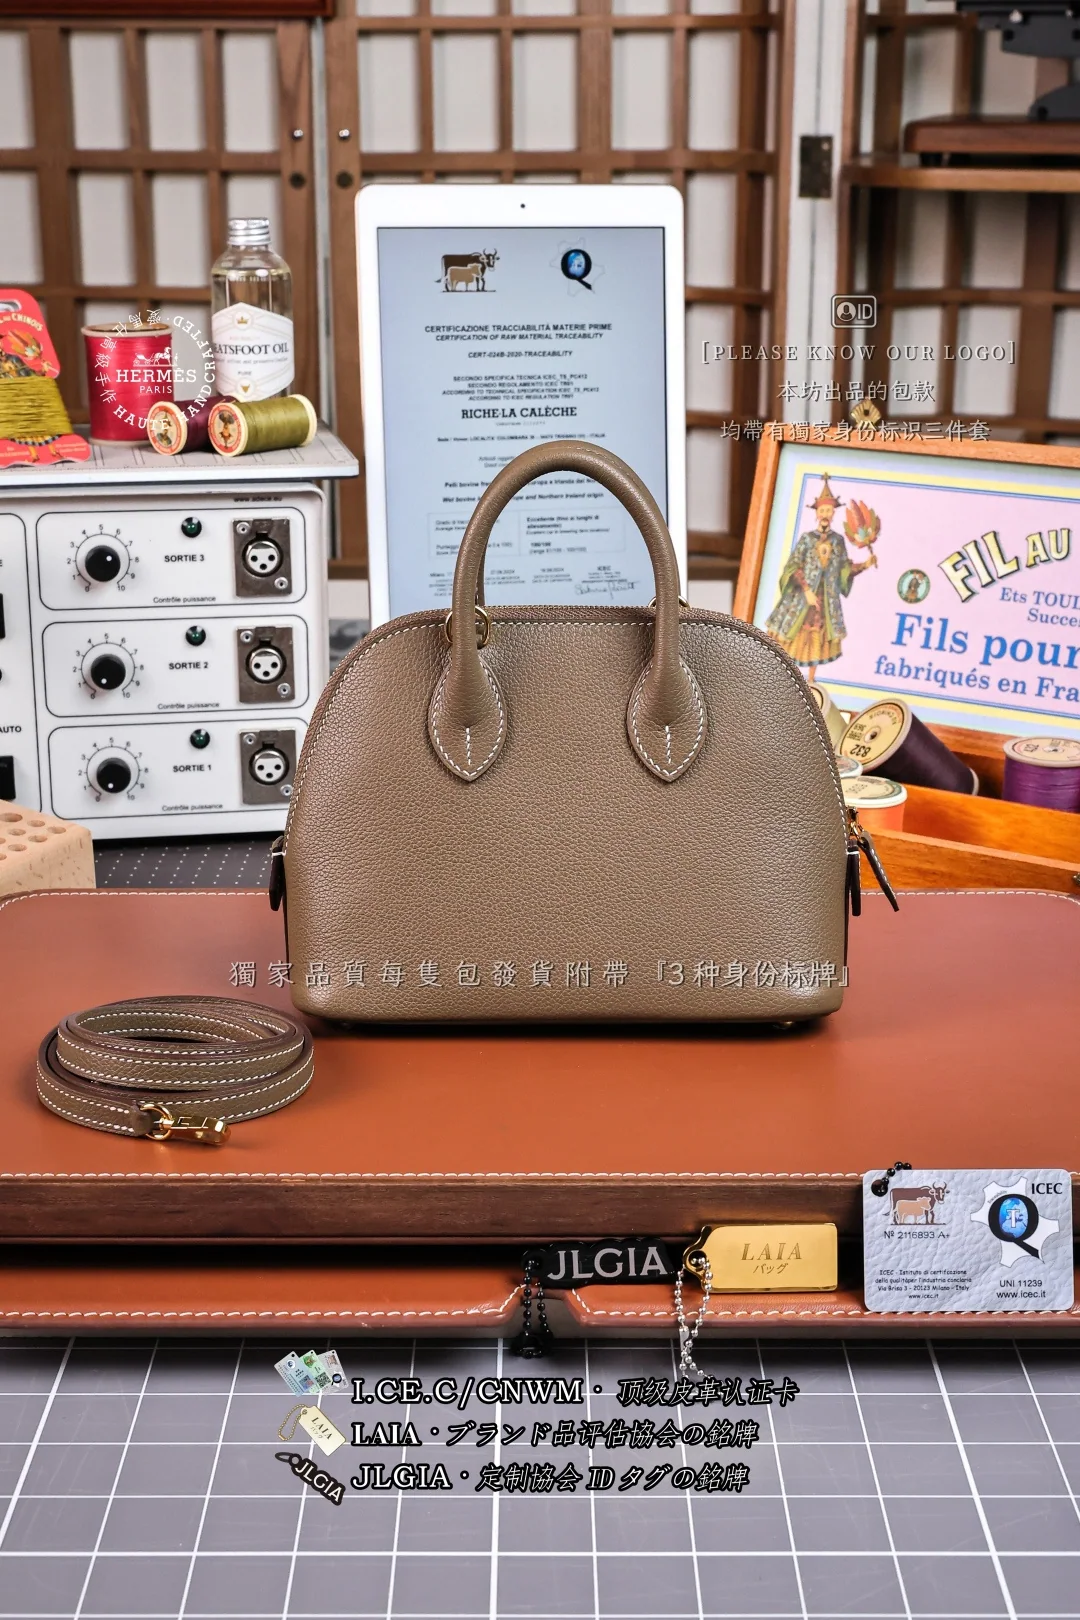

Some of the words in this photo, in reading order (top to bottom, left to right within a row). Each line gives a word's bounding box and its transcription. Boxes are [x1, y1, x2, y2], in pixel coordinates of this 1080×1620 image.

[552, 323, 586, 331] MATERIE
[555, 332, 604, 340] TRACEABILITY
[272, 342, 290, 354] OIL
[520, 404, 578, 418] CALÈCHE
[164, 554, 198, 563] SORTIE
[199, 554, 205, 562] 3
[938, 530, 1022, 604] FIL
[1025, 527, 1072, 569] AU
[130, 572, 136, 580] 9
[153, 596, 182, 604] Contrôle
[183, 595, 216, 604] puissance
[1000, 587, 1028, 604] Ets
[1027, 607, 1080, 628] Succe
[890, 612, 969, 654] Fils
[979, 633, 1080, 670] pour
[168, 662, 200, 670] SORTIE
[203, 661, 209, 670] 2
[874, 655, 991, 692] fabriqués
[1004, 676, 1028, 695] en
[1034, 676, 1080, 703] Fra
[186, 702, 220, 710] puissance
[849, 744, 872, 758] 832
[172, 764, 204, 773] SORTIE
[207, 764, 212, 772] 1
[1031, 1182, 1063, 1195] ICEC
[897, 1231, 935, 1240] 2116893
[937, 1231, 950, 1239] A+
[740, 1242, 802, 1261] LAIA
[547, 1246, 668, 1281] JLGIA
[752, 1262, 789, 1274] バッグ
[999, 1280, 1015, 1288] UNI
[1018, 1280, 1043, 1288] 11239
[996, 1290, 1046, 1299] www.icec.it
